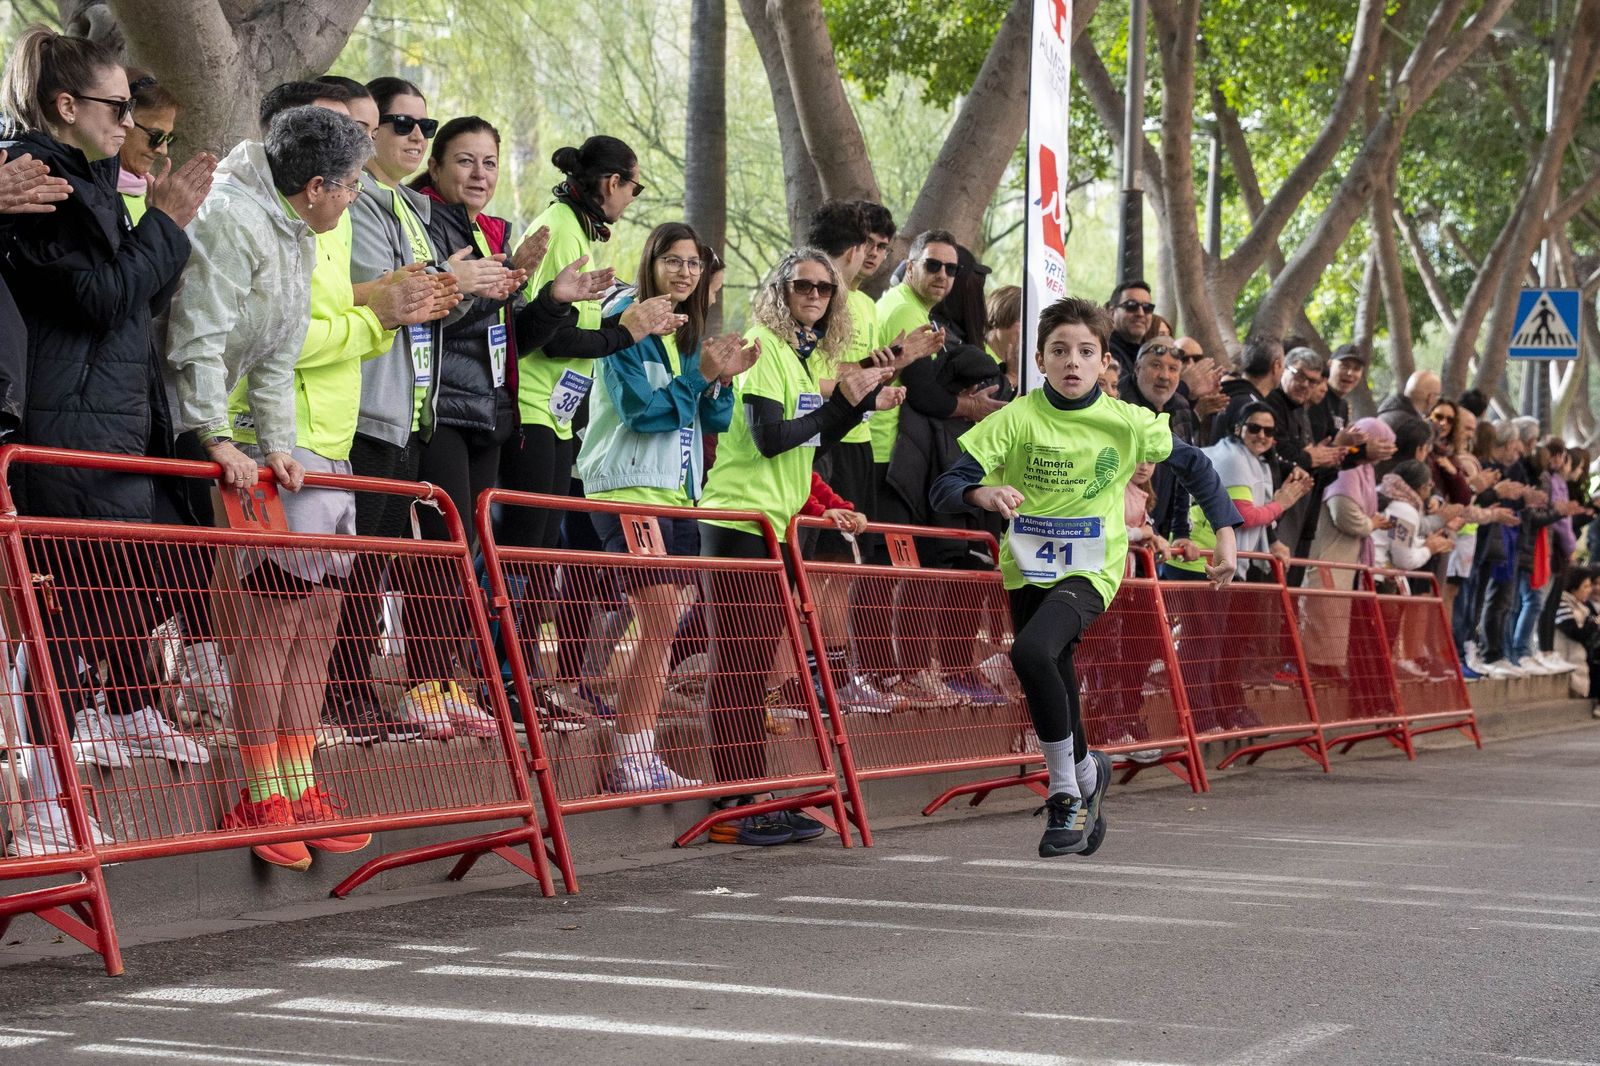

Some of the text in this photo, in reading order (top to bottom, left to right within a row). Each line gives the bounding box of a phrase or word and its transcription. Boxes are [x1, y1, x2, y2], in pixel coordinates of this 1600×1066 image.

[413, 346, 431, 369] 15
[556, 392, 581, 412] 38
[1033, 457, 1074, 469] Almería
[1023, 472, 1088, 485] contra el cáncer
[1035, 468, 1068, 477] marcha
[1024, 517, 1053, 527] Almería
[1065, 520, 1092, 528] marcha
[1022, 525, 1046, 534] contra
[1056, 528, 1082, 536] cáncer
[1036, 541, 1073, 566] 41
